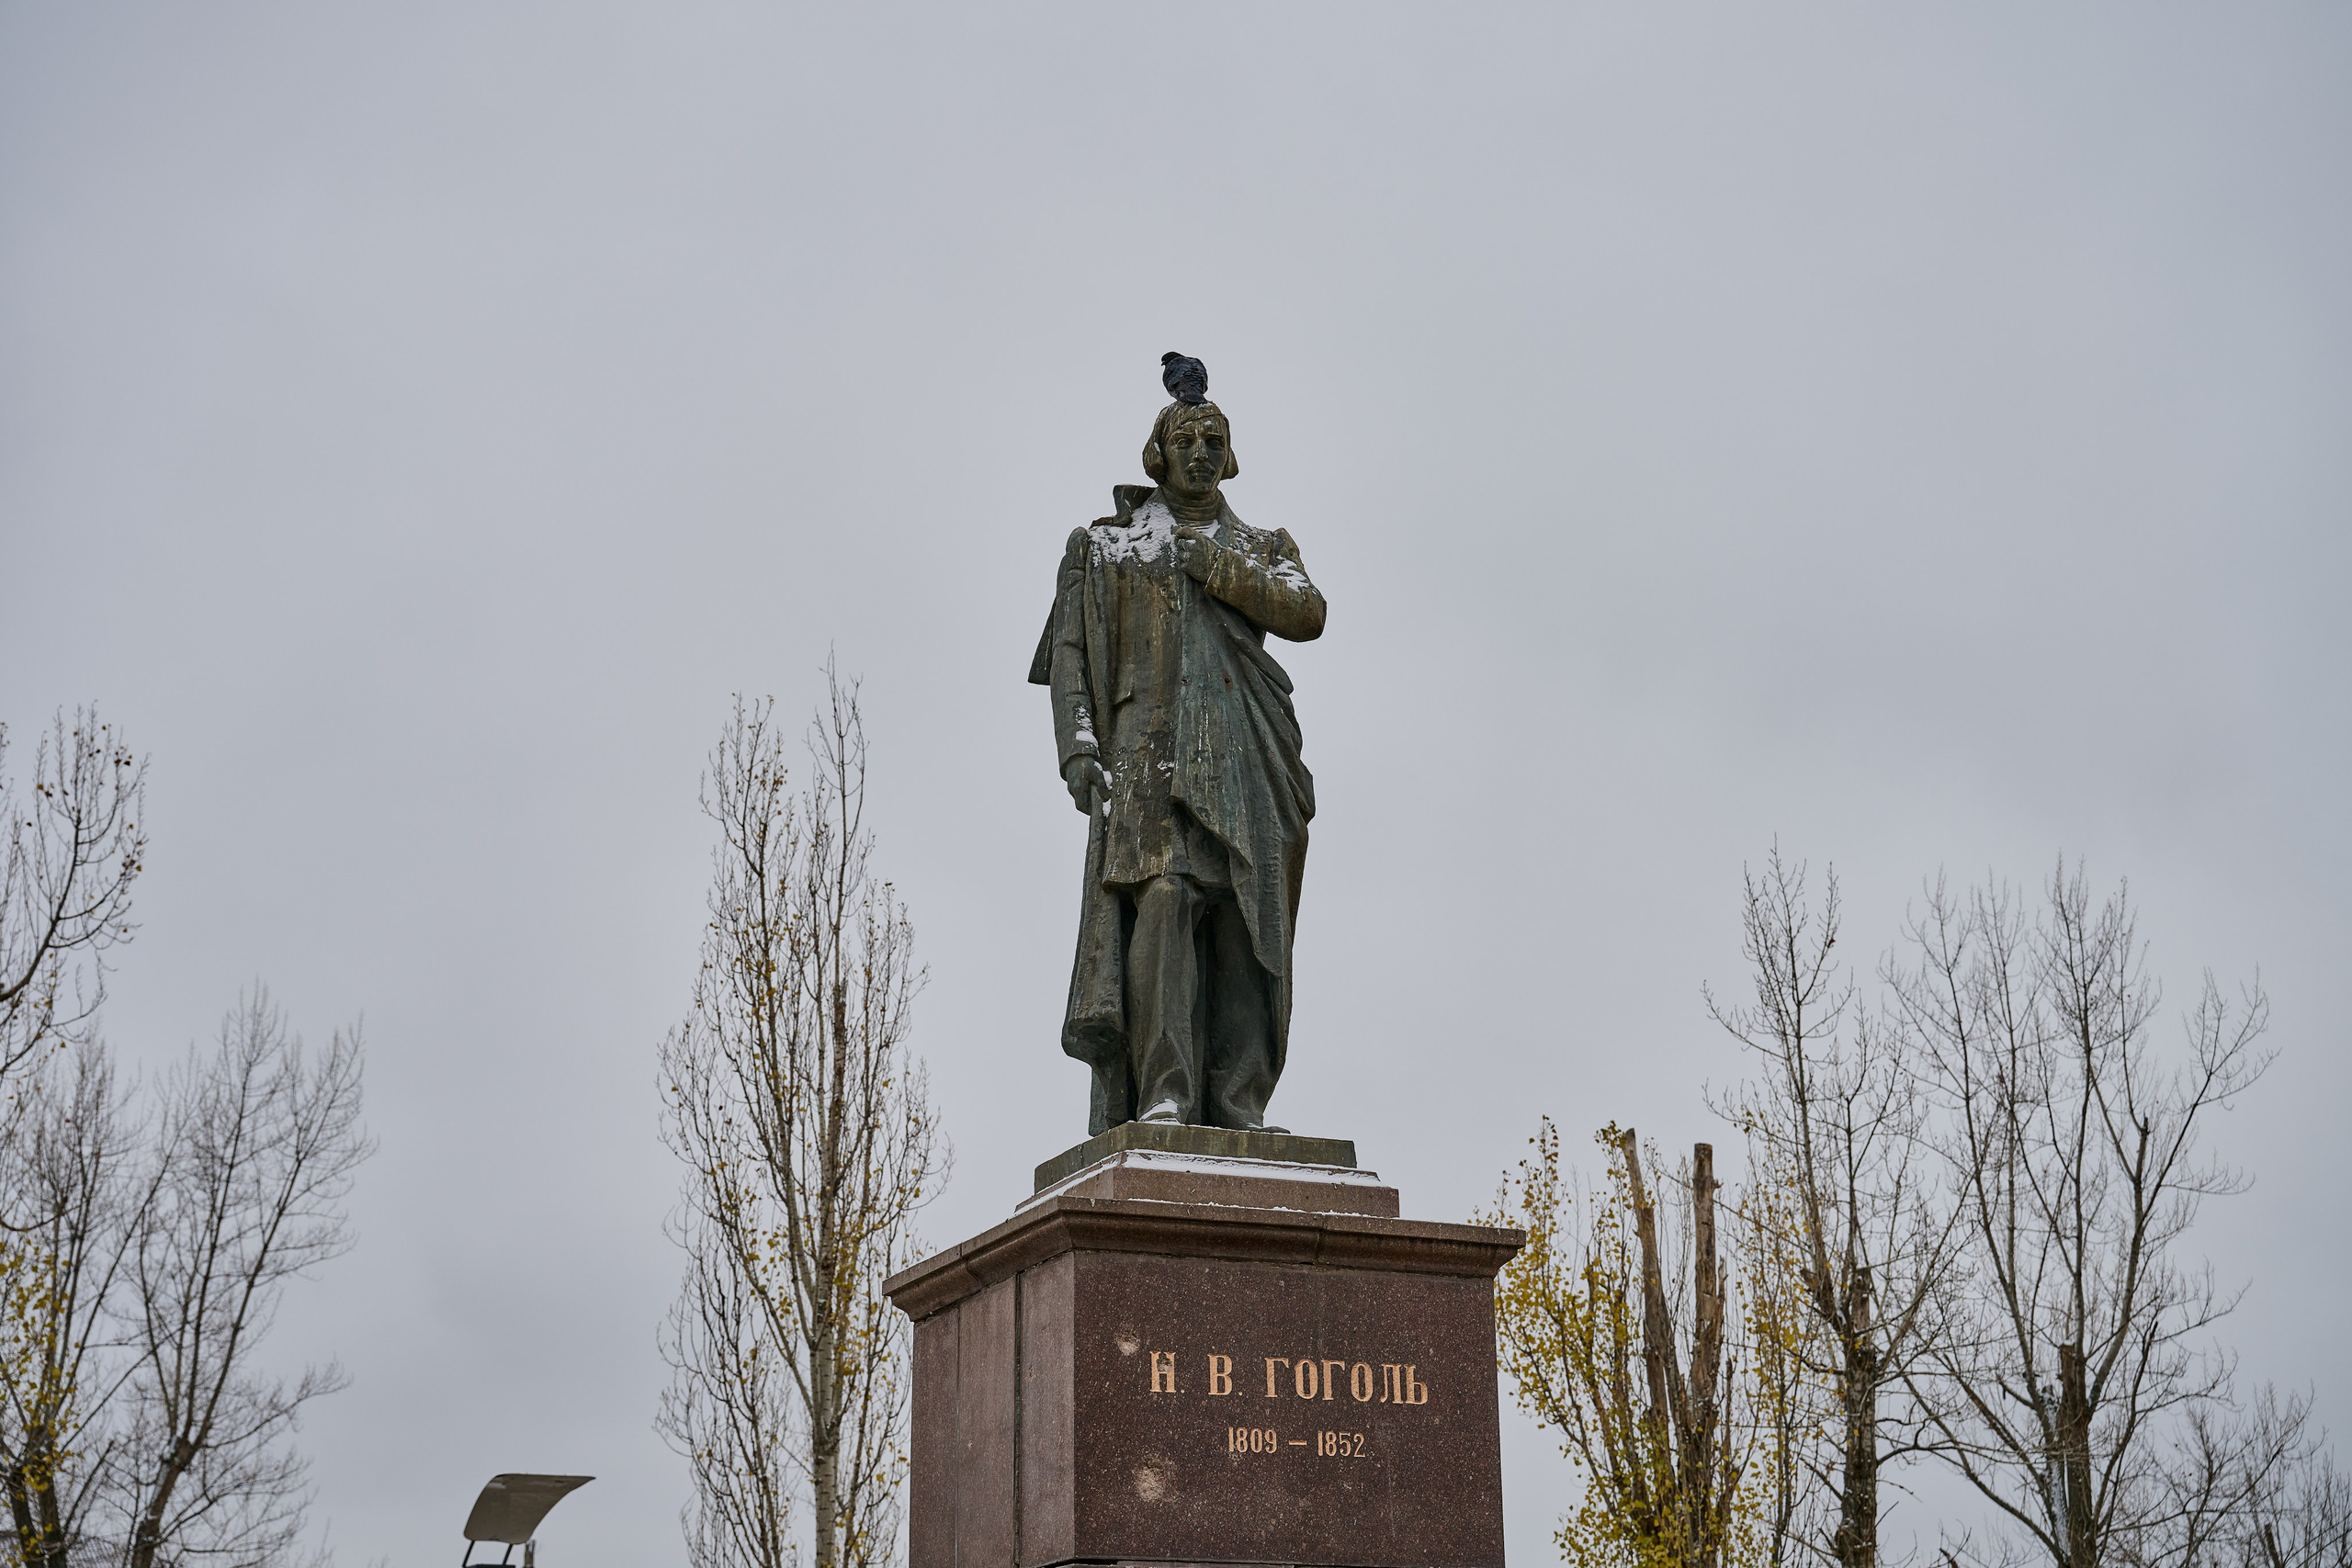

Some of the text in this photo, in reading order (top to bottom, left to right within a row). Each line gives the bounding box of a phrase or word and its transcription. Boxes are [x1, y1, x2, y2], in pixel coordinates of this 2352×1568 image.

[1149, 1350, 1429, 1405] Н. В. ГОГОЛЬ
[1227, 1426, 1278, 1454] 1809
[1317, 1430, 1366, 1459] 1852
